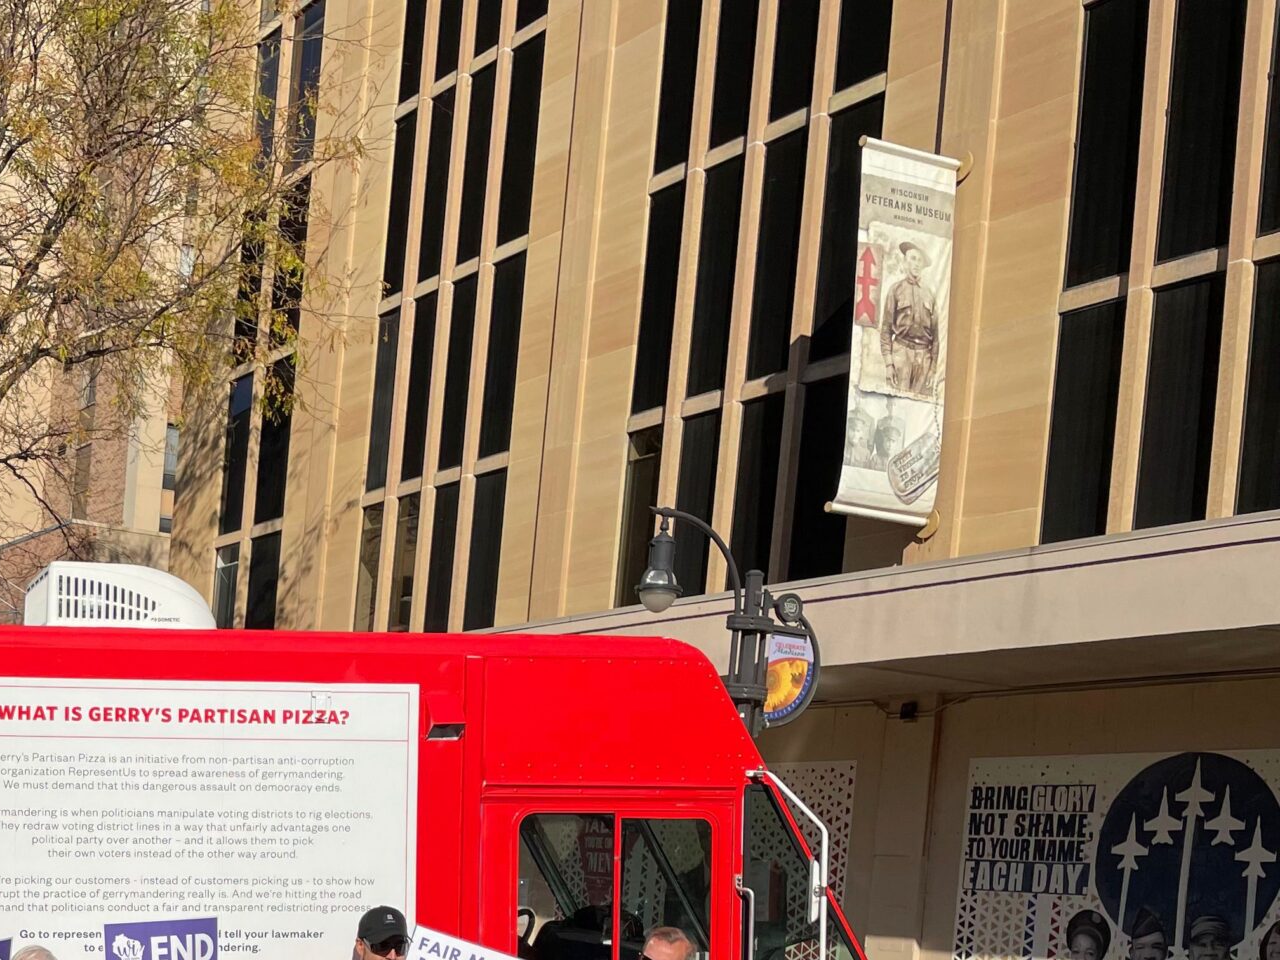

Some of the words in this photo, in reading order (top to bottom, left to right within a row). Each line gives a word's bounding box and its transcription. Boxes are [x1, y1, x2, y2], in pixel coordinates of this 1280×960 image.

[890, 187, 929, 202] WISCONSIN
[865, 193, 913, 213] VETERANS
[915, 204, 951, 222] MUSEUM
[64, 706, 82, 721] IS
[88, 706, 172, 723] GERRY'S
[178, 708, 276, 724] PARTISAN
[282, 709, 349, 725] PIZZA?
[31, 752, 75, 762] Partisan
[78, 752, 106, 763] Pizza
[108, 753, 117, 764] is
[119, 755, 132, 763] an
[135, 754, 179, 764] initiative
[181, 754, 206, 764] from
[208, 756, 274, 766] non-partisan
[276, 757, 354, 767] anti-corruption
[0, 766, 65, 778] organization
[68, 766, 136, 778] RepresentUs
[138, 768, 149, 777] to
[152, 768, 188, 779] spread
[190, 770, 246, 778] awareness
[248, 768, 260, 778] of
[261, 769, 344, 781] gerrymandering.
[2, 779, 20, 789] We
[22, 781, 50, 790] must
[51, 780, 94, 790] demand
[97, 781, 118, 791] that
[120, 781, 140, 791] this
[142, 781, 197, 793] dangerous
[199, 782, 236, 792] assault
[238, 784, 252, 792] on
[254, 783, 312, 793] democracy
[314, 783, 342, 792] ends.
[970, 785, 1029, 811] BRING
[1032, 785, 1096, 812] GLORY
[59, 807, 68, 817] is
[70, 807, 98, 817] when
[101, 808, 154, 819] politicians
[157, 808, 214, 819] manipulate
[216, 810, 249, 820] voting
[251, 809, 293, 819] districts
[295, 810, 306, 819] to
[308, 810, 322, 821] rig
[324, 809, 373, 819] elections.
[22, 821, 59, 831] redraw
[61, 822, 94, 833] voting
[96, 821, 134, 831] district
[136, 821, 160, 831] lines
[162, 822, 171, 831] in
[183, 824, 203, 833] way
[206, 822, 227, 832] that
[229, 822, 267, 833] unfairly
[270, 822, 329, 834] advantages
[331, 824, 350, 833] one
[969, 813, 1008, 837] NOT
[1014, 813, 1094, 841] SHAME,
[968, 838, 986, 859] TO
[989, 839, 1030, 861] YOUR
[1033, 841, 1084, 862] NAME
[965, 862, 1020, 892] EACH
[1032, 863, 1089, 895] DAY.
[19, 929, 35, 939] Go
[38, 930, 50, 939] to
[52, 930, 102, 942] represen
[224, 929, 241, 938] tell
[244, 931, 268, 940] your
[271, 929, 324, 938] lawmaker
